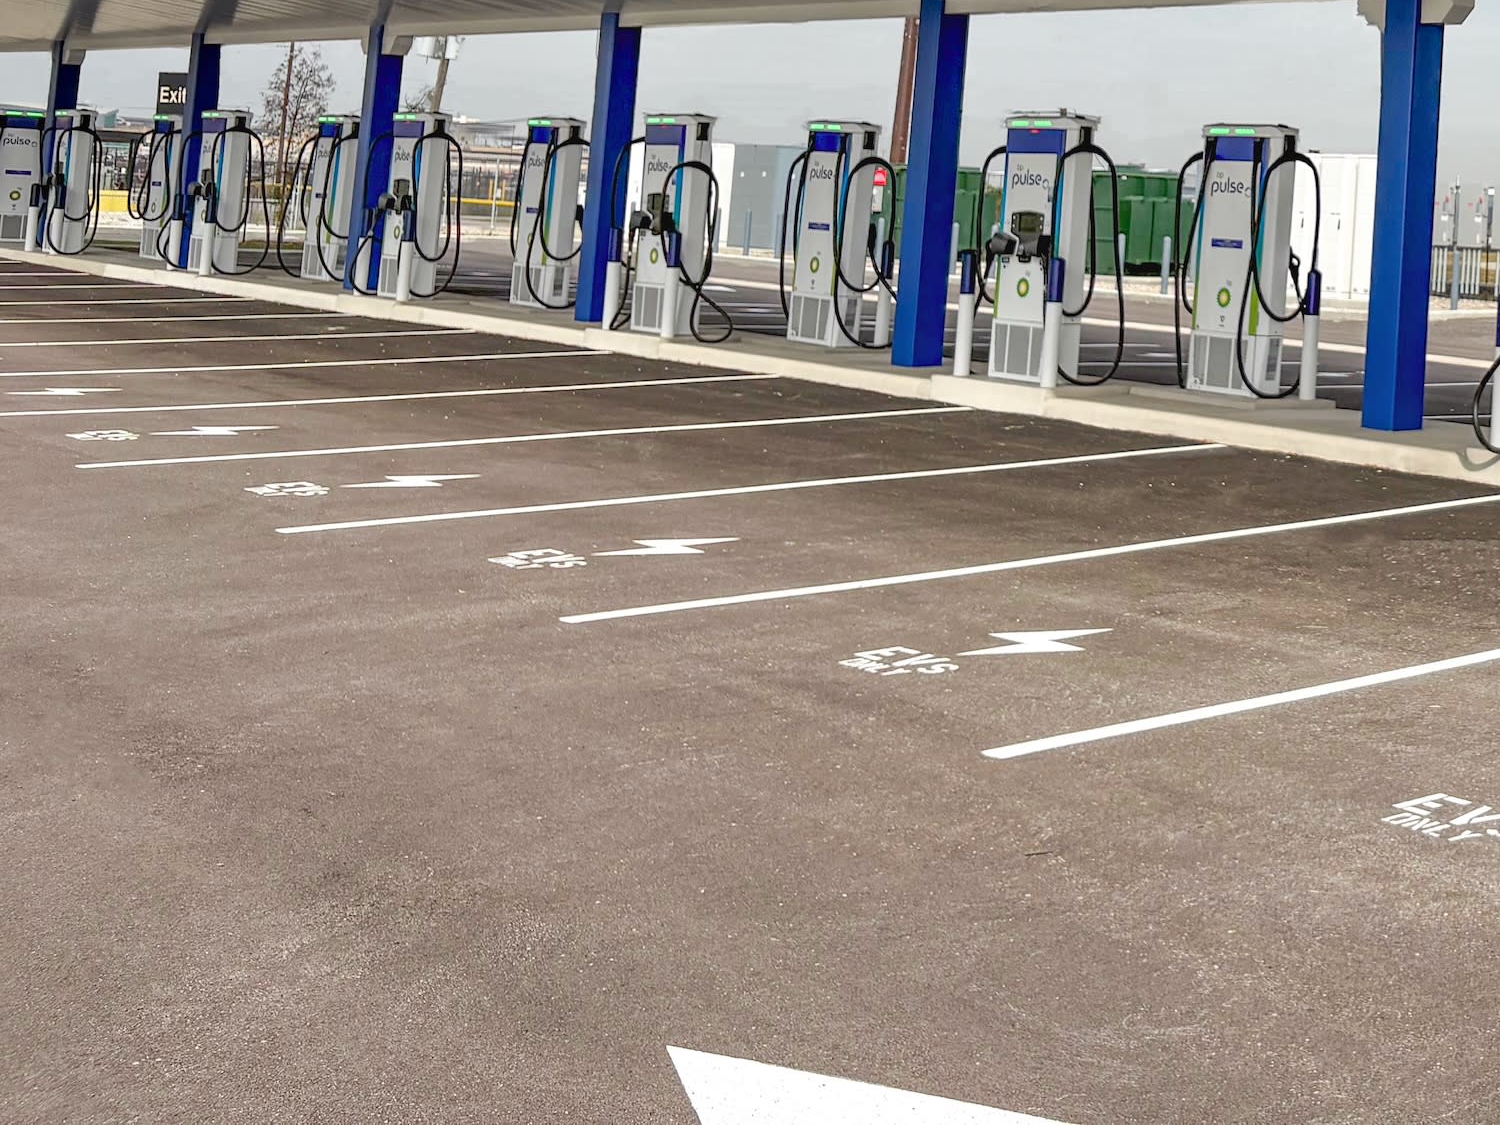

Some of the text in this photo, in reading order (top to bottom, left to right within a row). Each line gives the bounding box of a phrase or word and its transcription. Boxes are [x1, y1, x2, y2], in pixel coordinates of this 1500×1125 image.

[1011, 168, 1042, 189] pulse
[1211, 176, 1244, 197] pulse
[1380, 812, 1484, 842] ONLY
